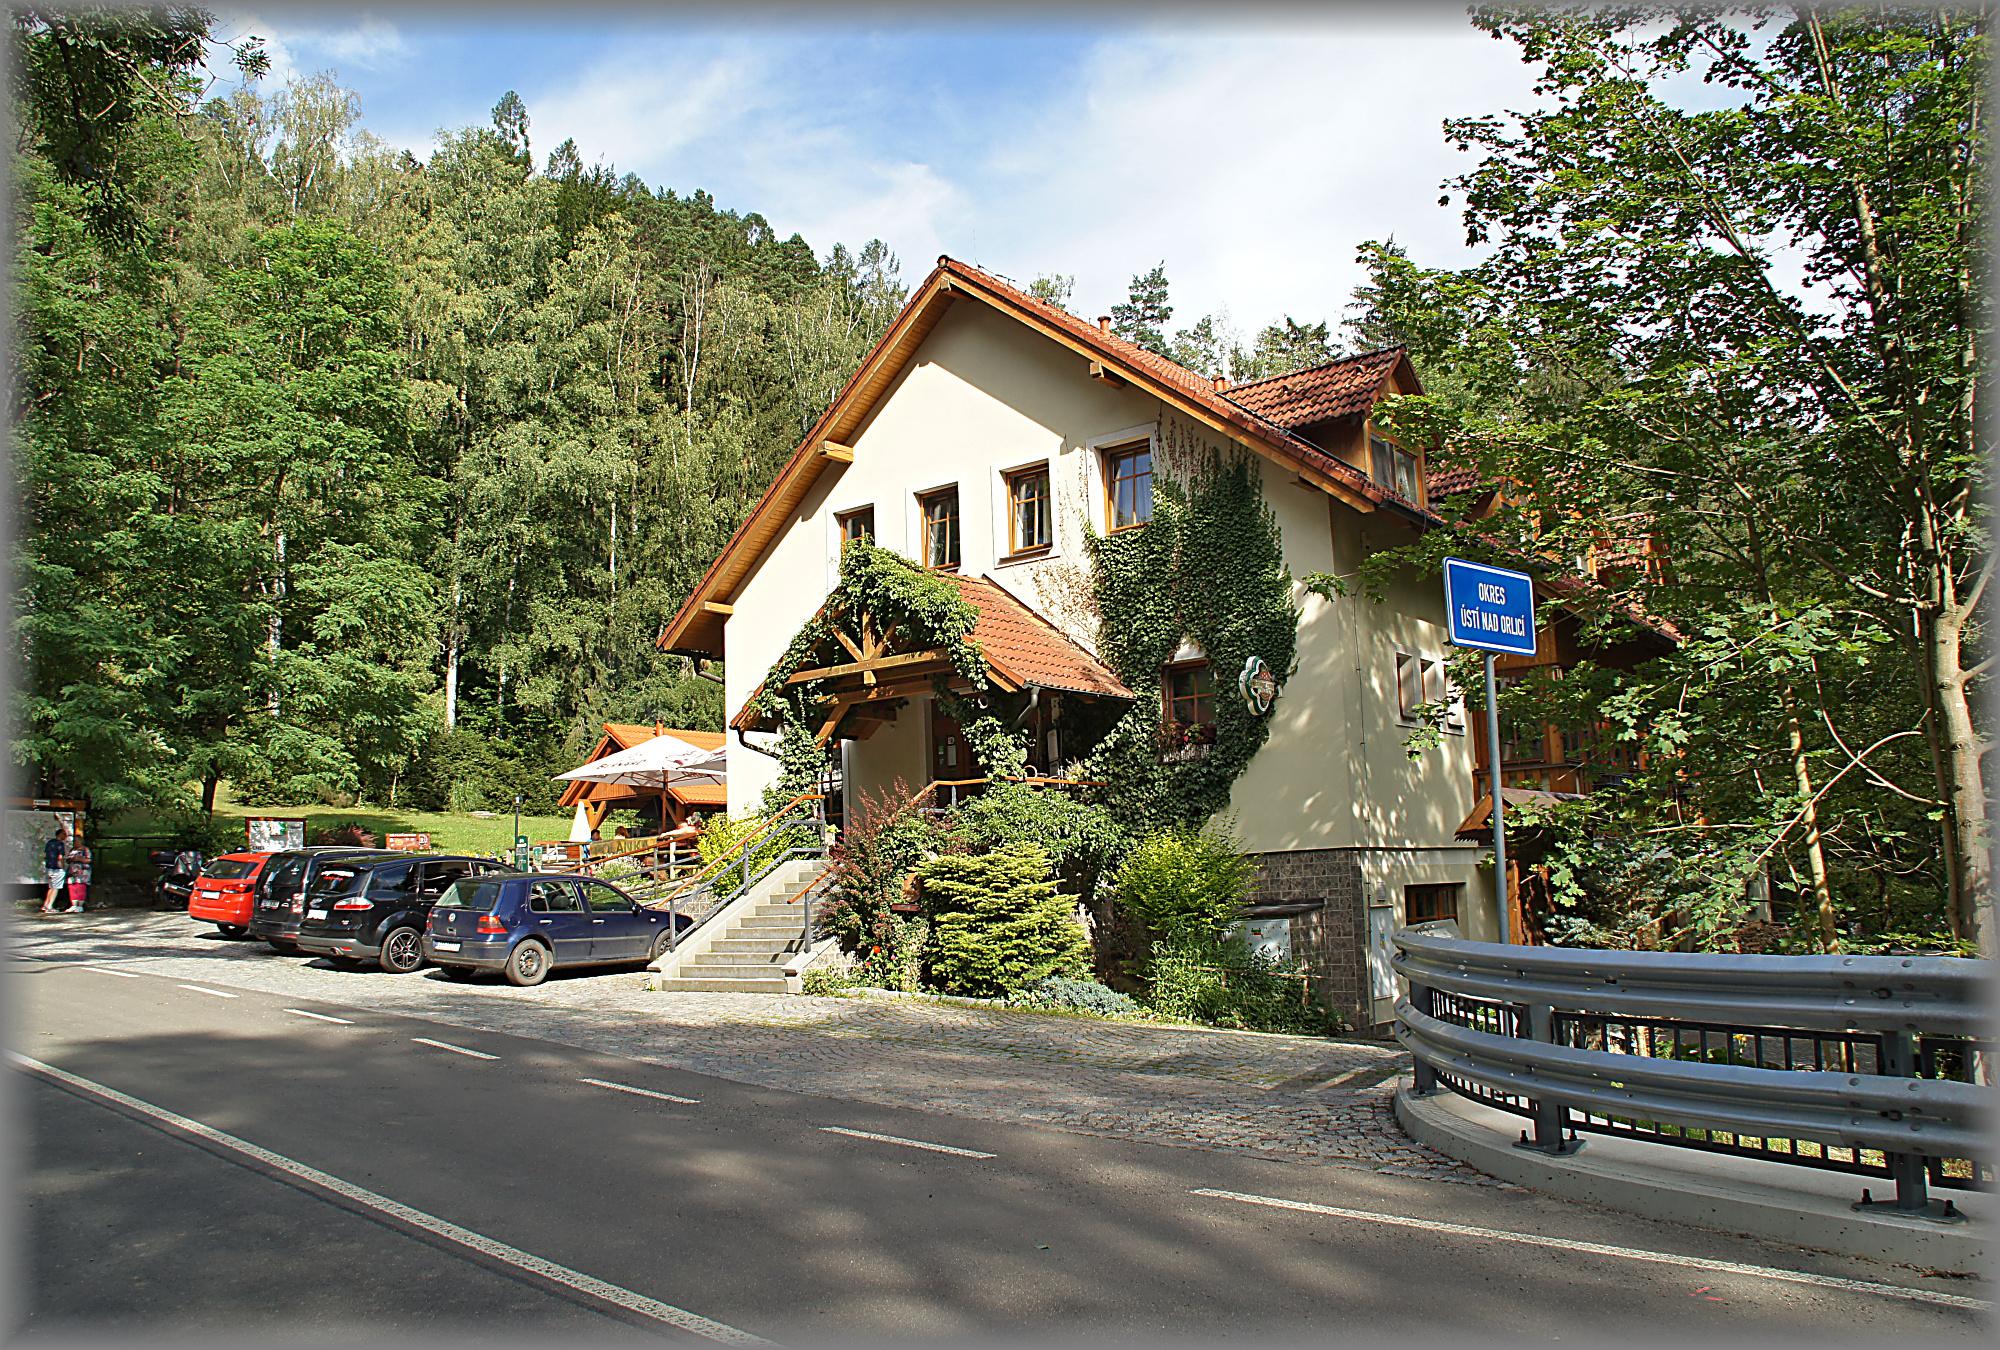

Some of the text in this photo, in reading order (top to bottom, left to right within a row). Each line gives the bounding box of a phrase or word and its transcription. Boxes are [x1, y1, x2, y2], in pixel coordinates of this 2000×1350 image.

[1478, 583, 1505, 605] OKRES
[1461, 604, 1525, 636] ÚSTÍ NAD ORLICÍ
